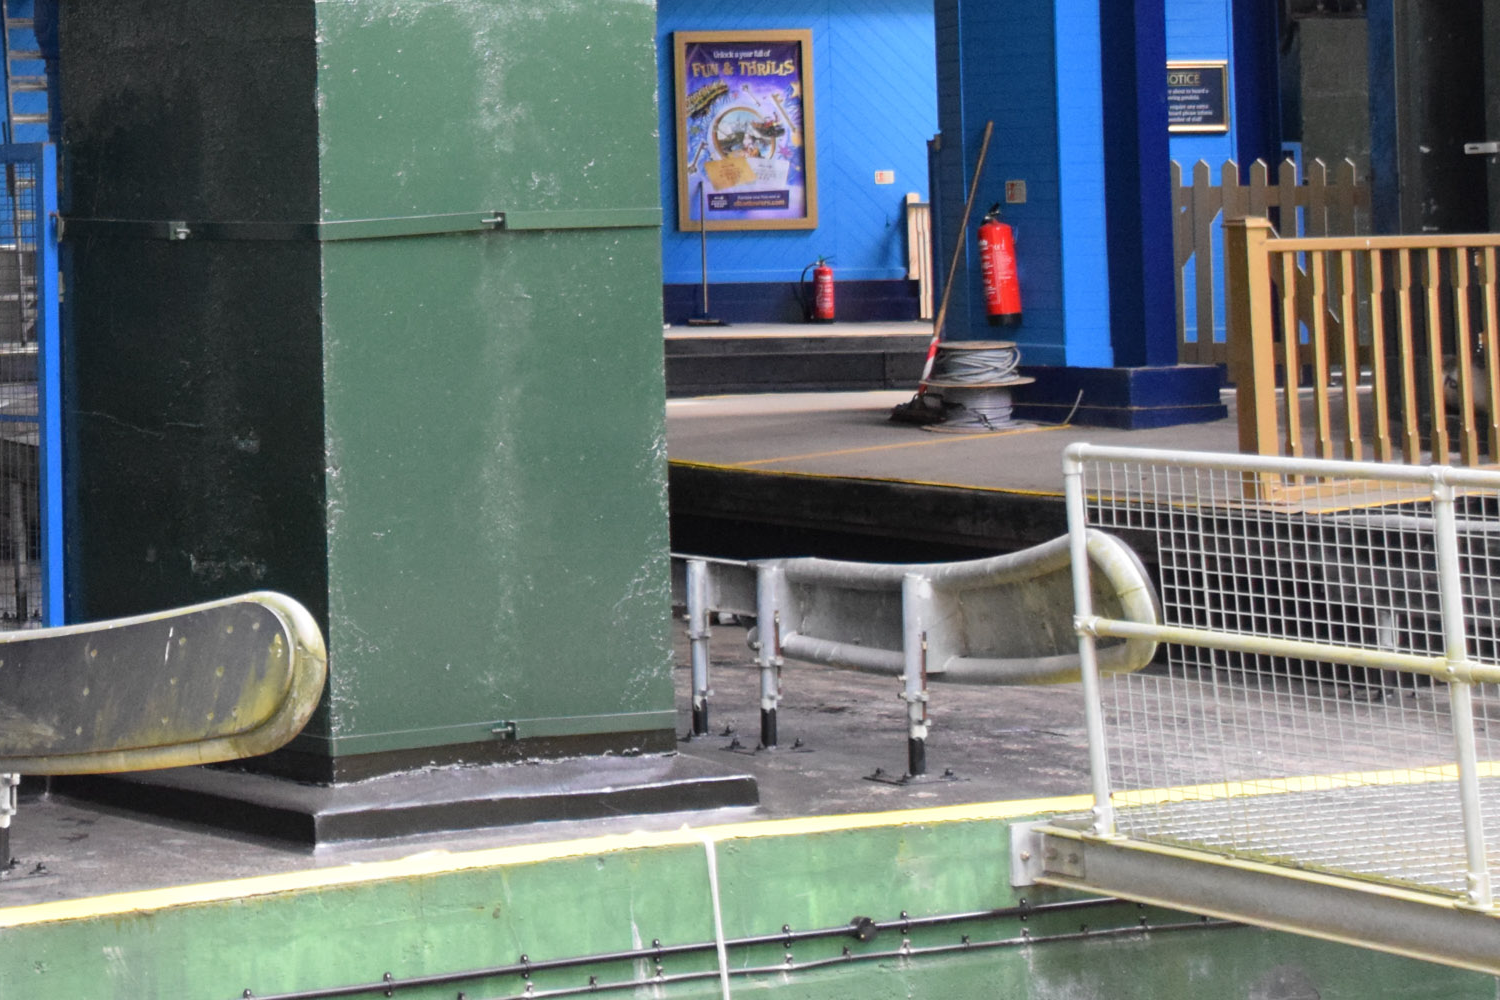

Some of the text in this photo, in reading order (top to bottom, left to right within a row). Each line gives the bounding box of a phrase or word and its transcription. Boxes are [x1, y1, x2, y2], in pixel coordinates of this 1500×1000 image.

[691, 59, 795, 78] FUN & THRILLS
[1167, 74, 1200, 85] OTICE
